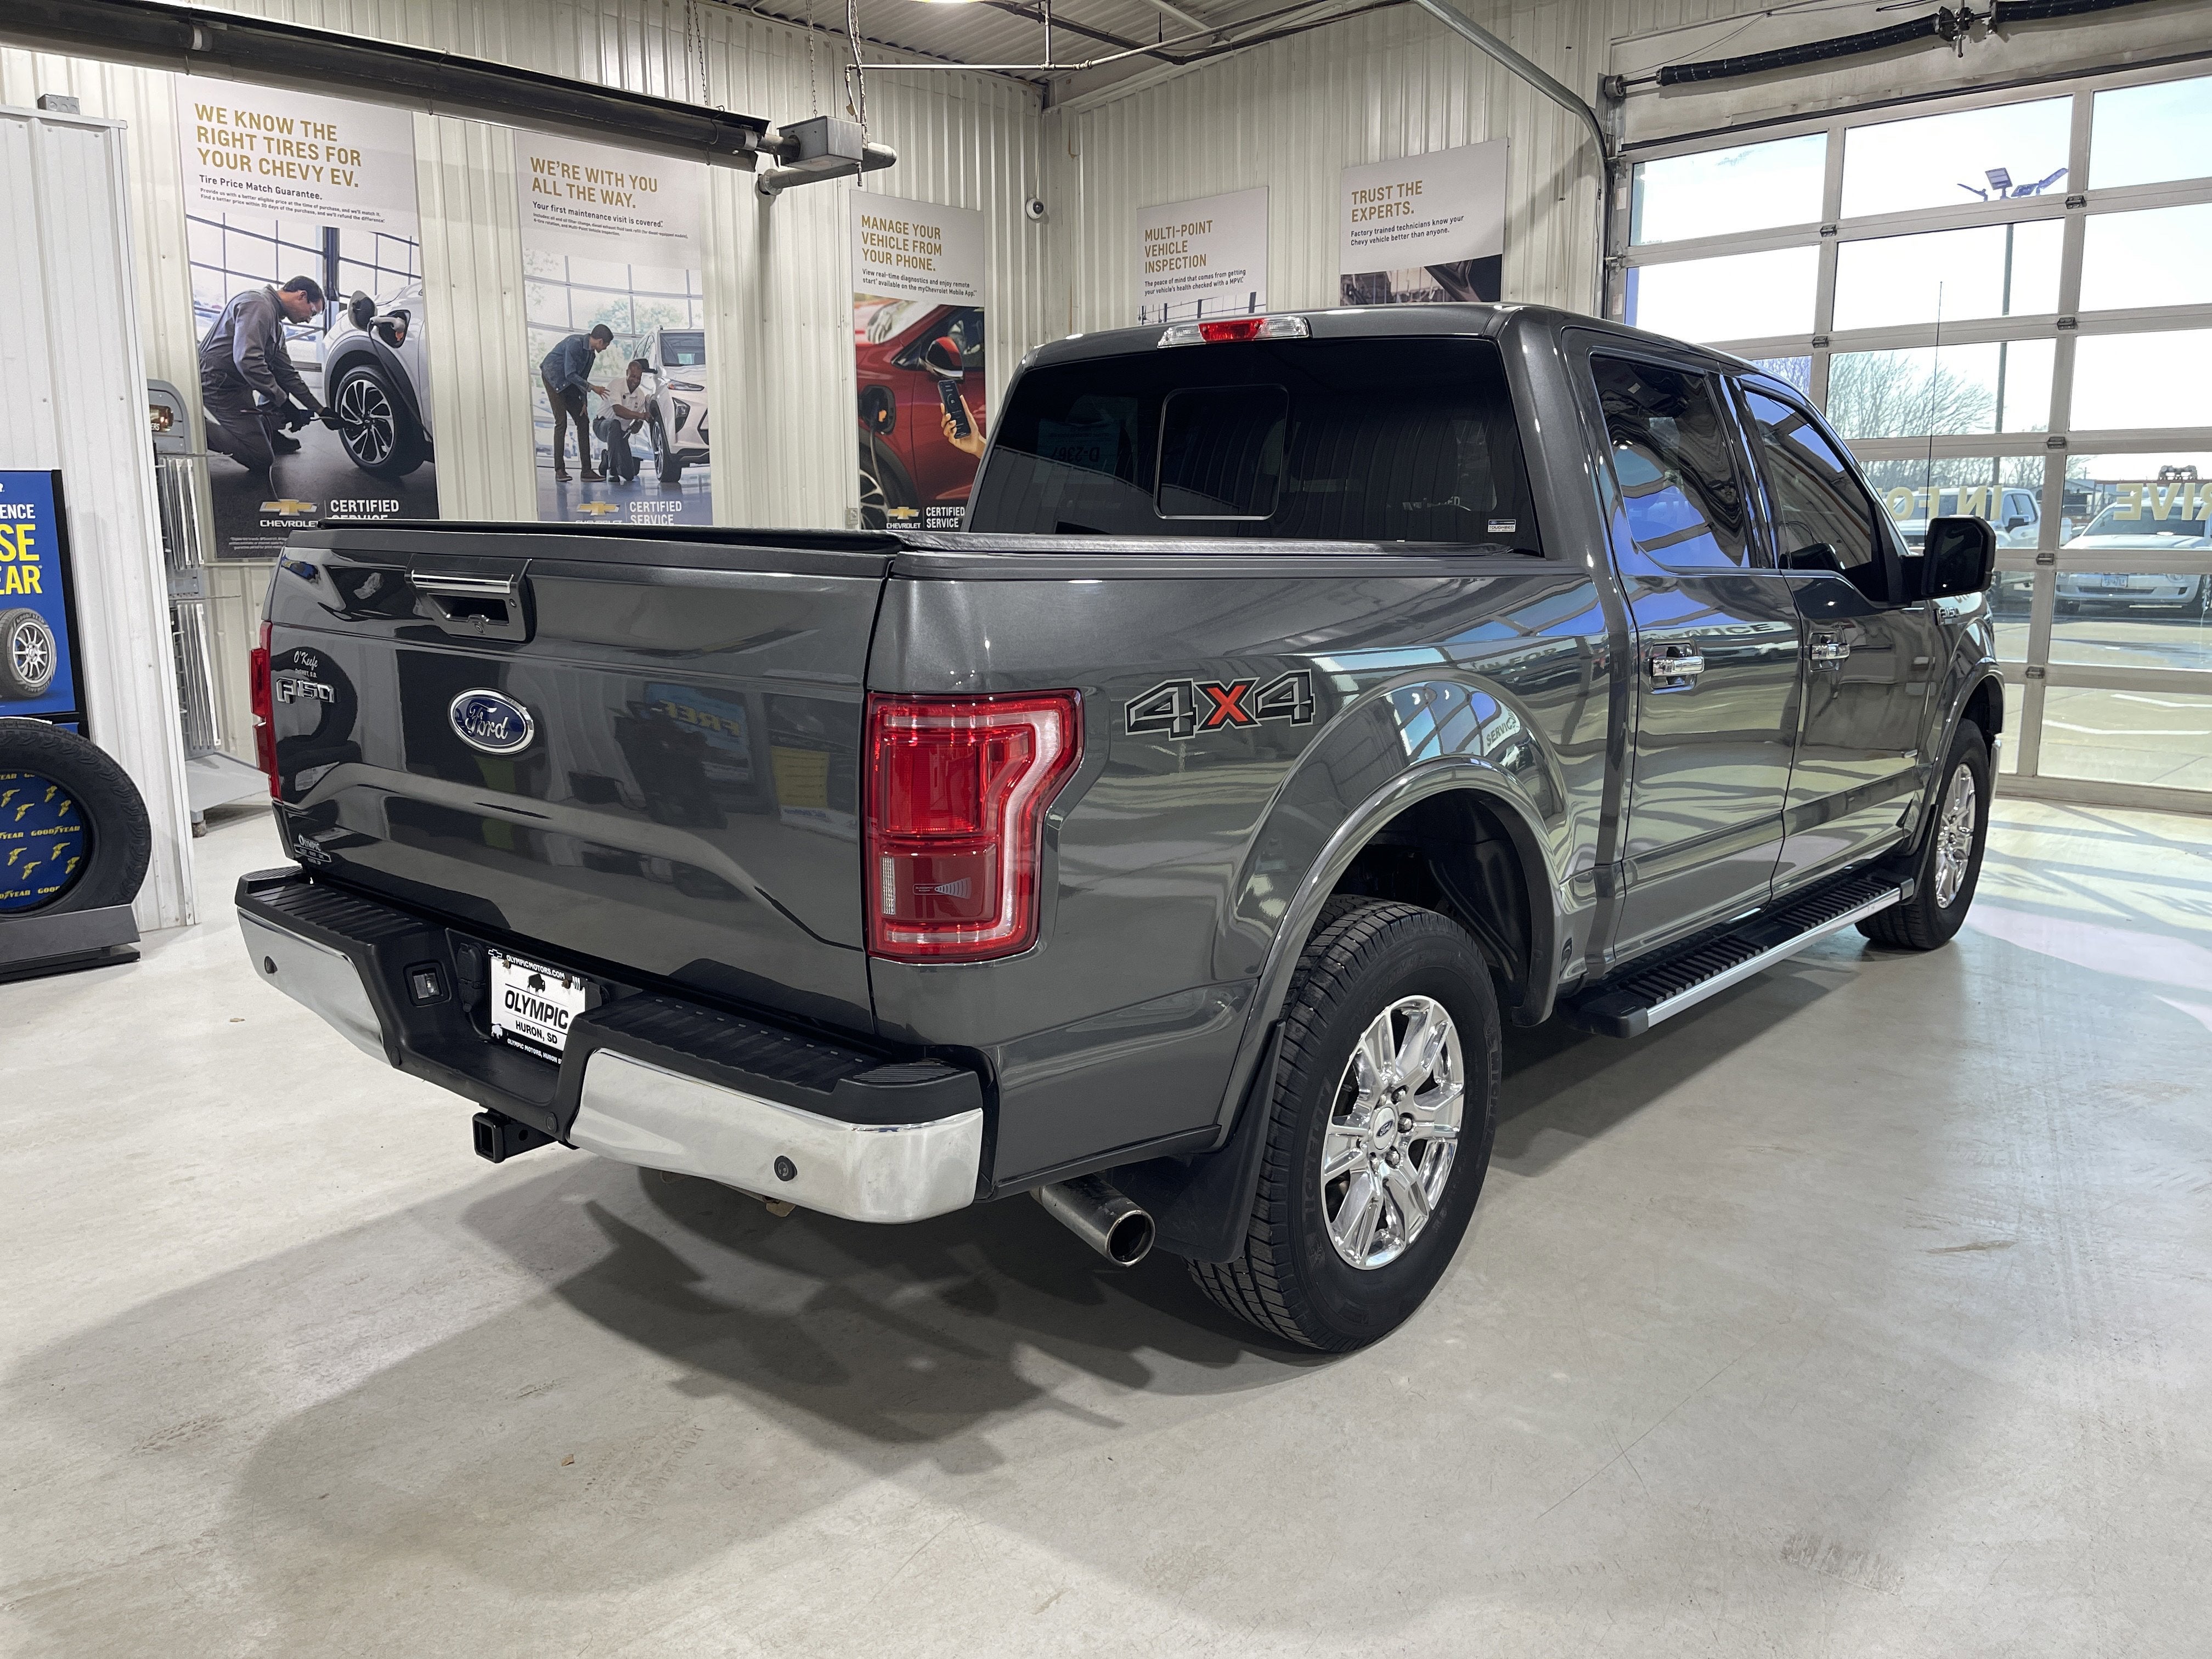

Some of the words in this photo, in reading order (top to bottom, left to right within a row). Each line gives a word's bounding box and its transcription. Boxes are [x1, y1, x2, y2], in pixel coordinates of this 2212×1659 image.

[195, 103, 228, 125] WE
[234, 110, 294, 135] KNOW
[300, 120, 337, 142] THE
[197, 126, 257, 151] RIGHT
[263, 136, 319, 160] TIRES
[326, 145, 362, 167] FOR
[197, 148, 252, 173] YOUR
[258, 158, 324, 183] CHEVY
[330, 168, 359, 188] EV.
[199, 174, 218, 185] Tire
[220, 178, 244, 189] Price
[246, 182, 273, 193] Match
[275, 186, 323, 200] Guarantee.
[585, 167, 625, 188] WITH
[629, 174, 658, 193] YOU
[532, 177, 562, 197] ALL
[566, 183, 596, 202] THE
[601, 189, 636, 208] WAY.
[1351, 185, 1393, 205] TRUST
[1397, 180, 1423, 198] THE
[533, 201, 549, 211] Your
[550, 205, 567, 214] first
[568, 209, 612, 221] maintenance
[613, 215, 627, 223] visit
[1351, 201, 1414, 223] EXPERTS.
[861, 215, 909, 235] MANAGE
[912, 223, 941, 240] YOUR
[1145, 220, 1213, 242] MULTI-POINT
[1351, 228, 1373, 238] Factory
[1374, 225, 1395, 235] trained
[1396, 221, 1431, 232] technicians
[1432, 218, 1448, 227] know
[1449, 215, 1464, 225] your
[1351, 238, 1368, 246] Chevy
[1369, 235, 1390, 245] vehicle
[1391, 232, 1410, 242] better
[1411, 230, 1425, 239] than
[1426, 227, 1450, 236] anyone.
[861, 231, 909, 251] VEHICLE
[912, 240, 942, 256] FROM
[1145, 240, 1188, 258] VEHICLE
[861, 247, 893, 266] YOUR
[896, 254, 936, 272] PHONE.
[1145, 253, 1207, 274] INSPECTION
[876, 272, 900, 280] real-time
[900, 275, 929, 285] diagnostics
[878, 280, 901, 289] available
[918, 286, 948, 295] myChevrolet
[1144, 289, 1155, 297] your
[1156, 284, 1176, 295] vehicle's
[1176, 283, 1192, 291] health
[1192, 281, 1213, 290] checked
[1154, 279, 1167, 288] peace
[1228, 269, 1246, 279] getting
[330, 499, 400, 513] CERTIFIED
[629, 500, 682, 513] CERTIFIED
[926, 506, 966, 517] CERTIFIED
[630, 514, 674, 526] SERVICE
[926, 518, 960, 528] SERVICE
[294, 650, 319, 671] O'Keefe
[465, 702, 509, 740] Ford
[506, 955, 566, 980] OLYMPICMOTORS.COM
[505, 990, 569, 1030] OLYMPIC
[515, 1020, 545, 1041] HURON,
[547, 1033, 558, 1045] SD
[507, 1038, 524, 1050] OLYMPIC
[524, 1045, 543, 1058] MOTORS,
[543, 1052, 558, 1063] HURON
